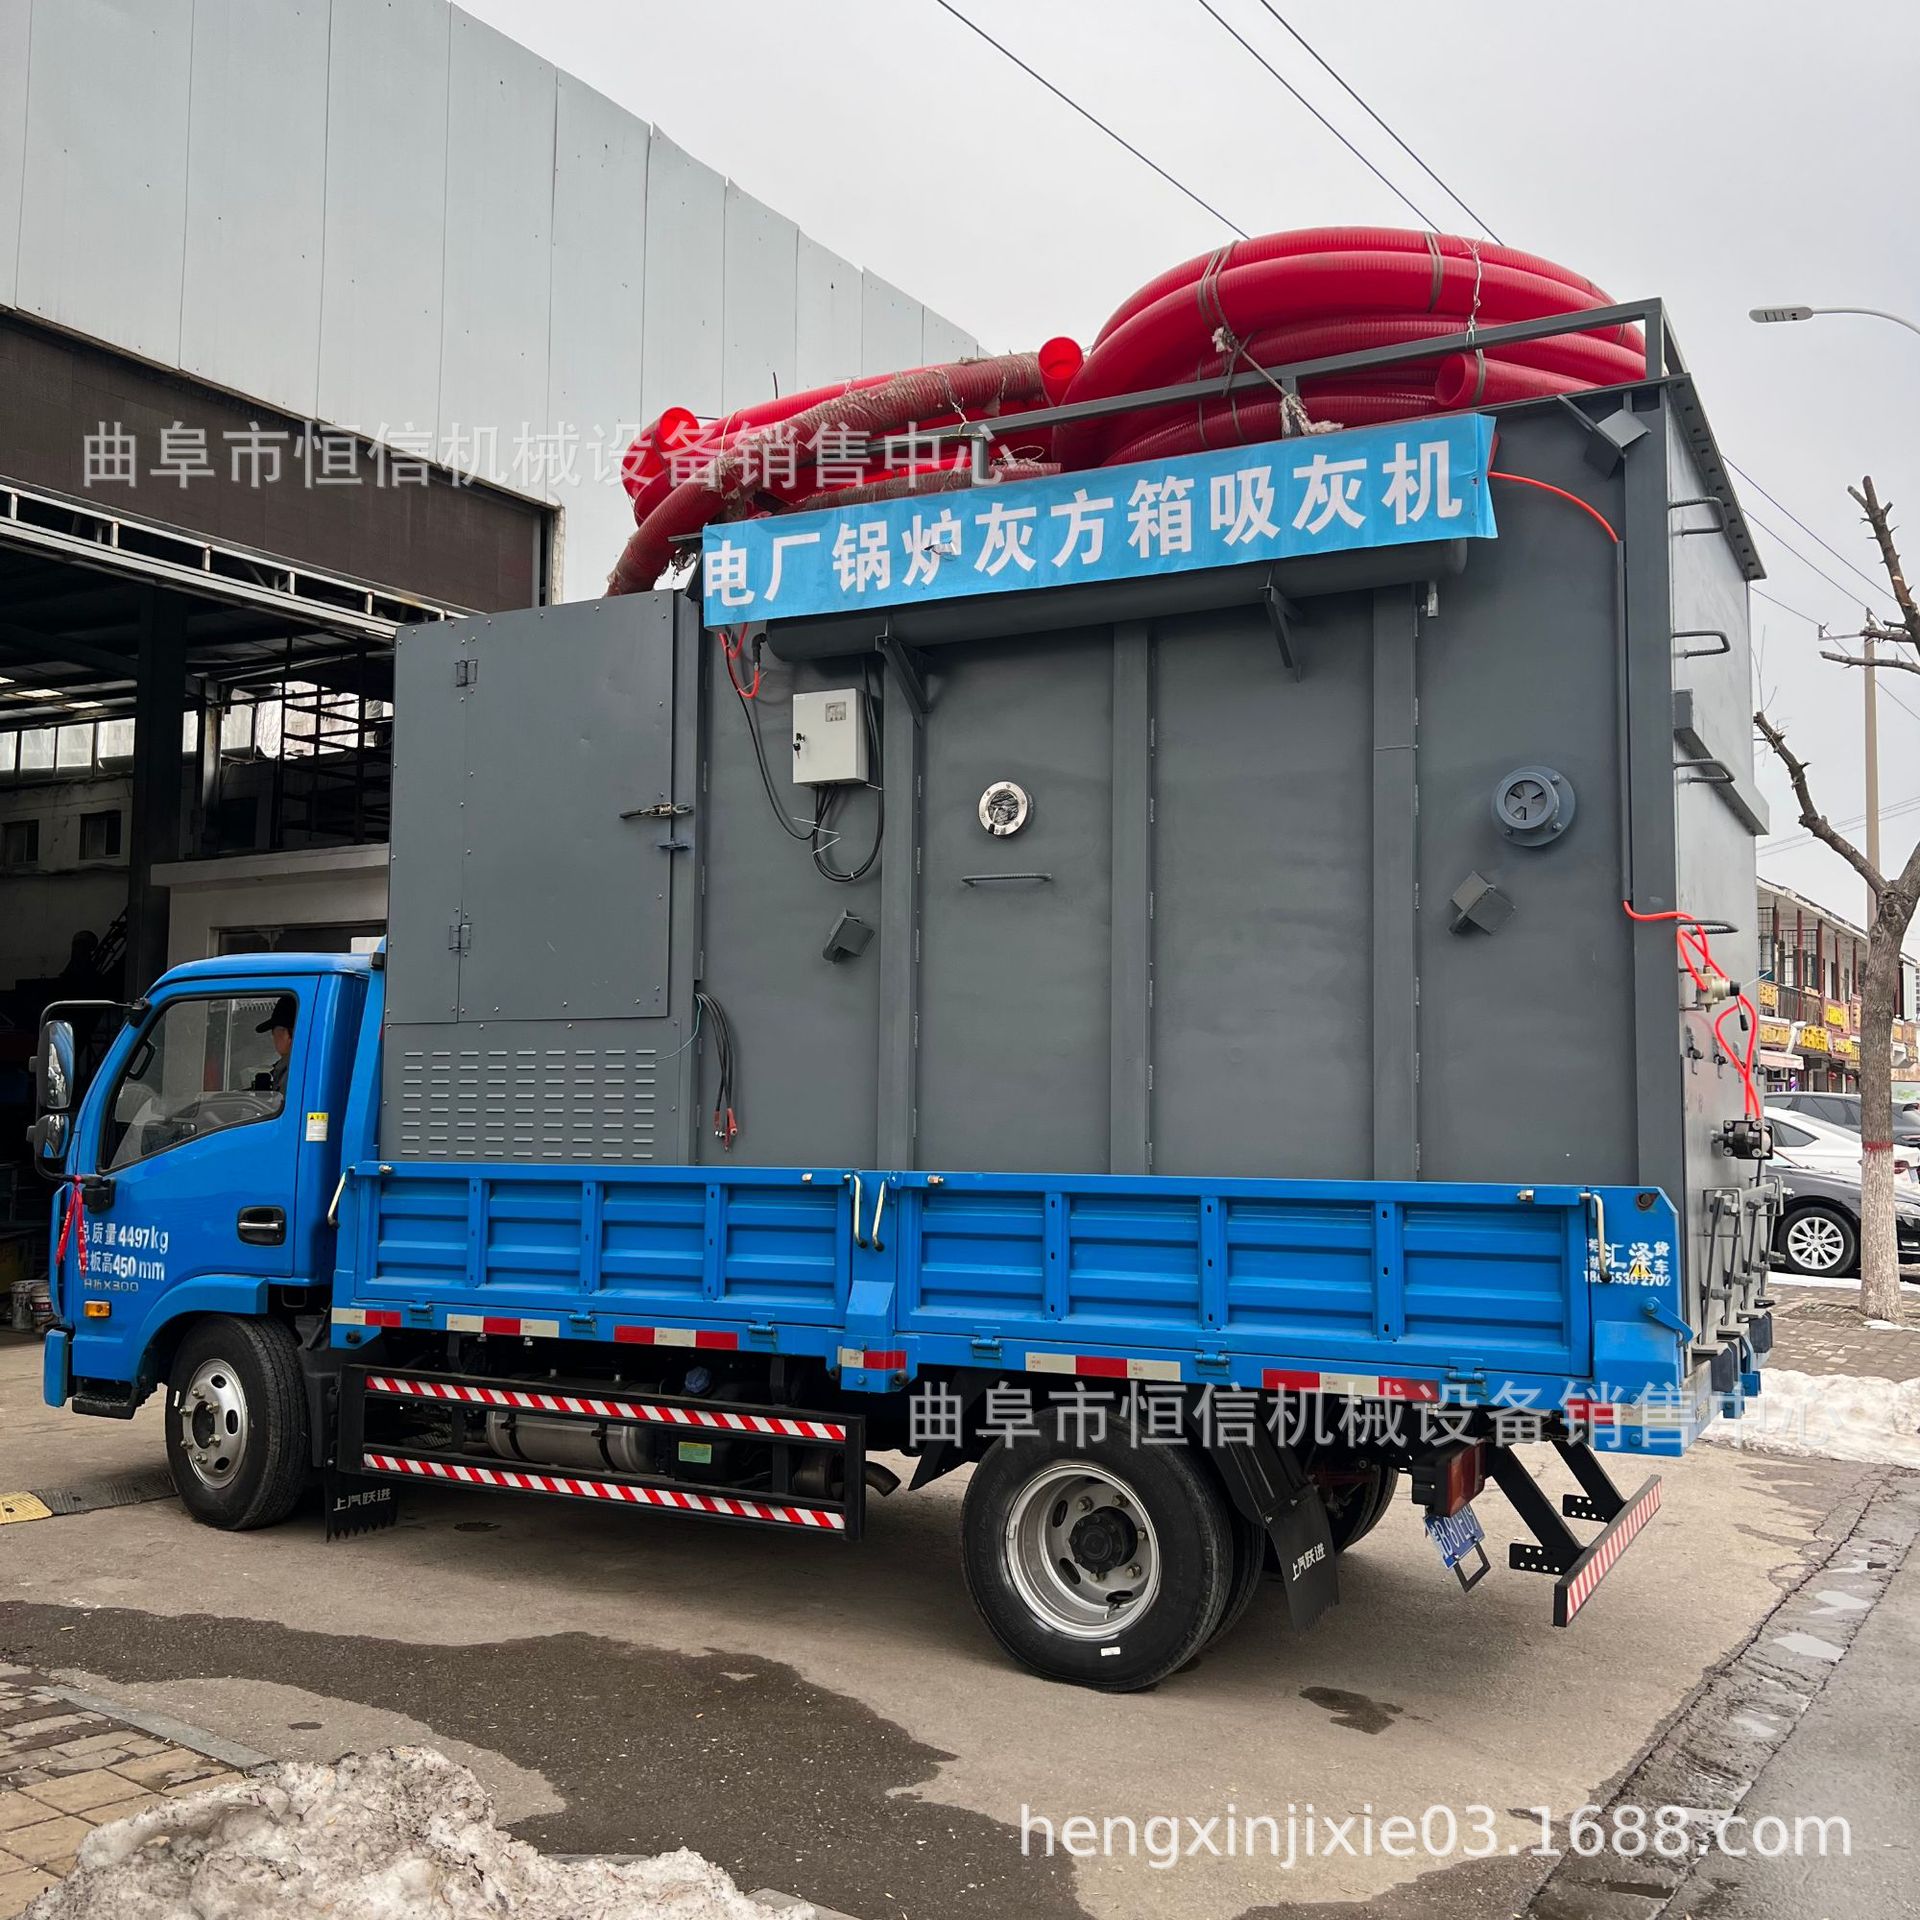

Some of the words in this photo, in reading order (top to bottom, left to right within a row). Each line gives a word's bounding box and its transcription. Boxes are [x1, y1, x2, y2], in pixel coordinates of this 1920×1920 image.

[704, 440, 1463, 608] 电厂锅炉灰方箱吸灰机
[333, 1488, 391, 1511] 上汽跃进
[1292, 1542, 1326, 1581] 上汽跃进
